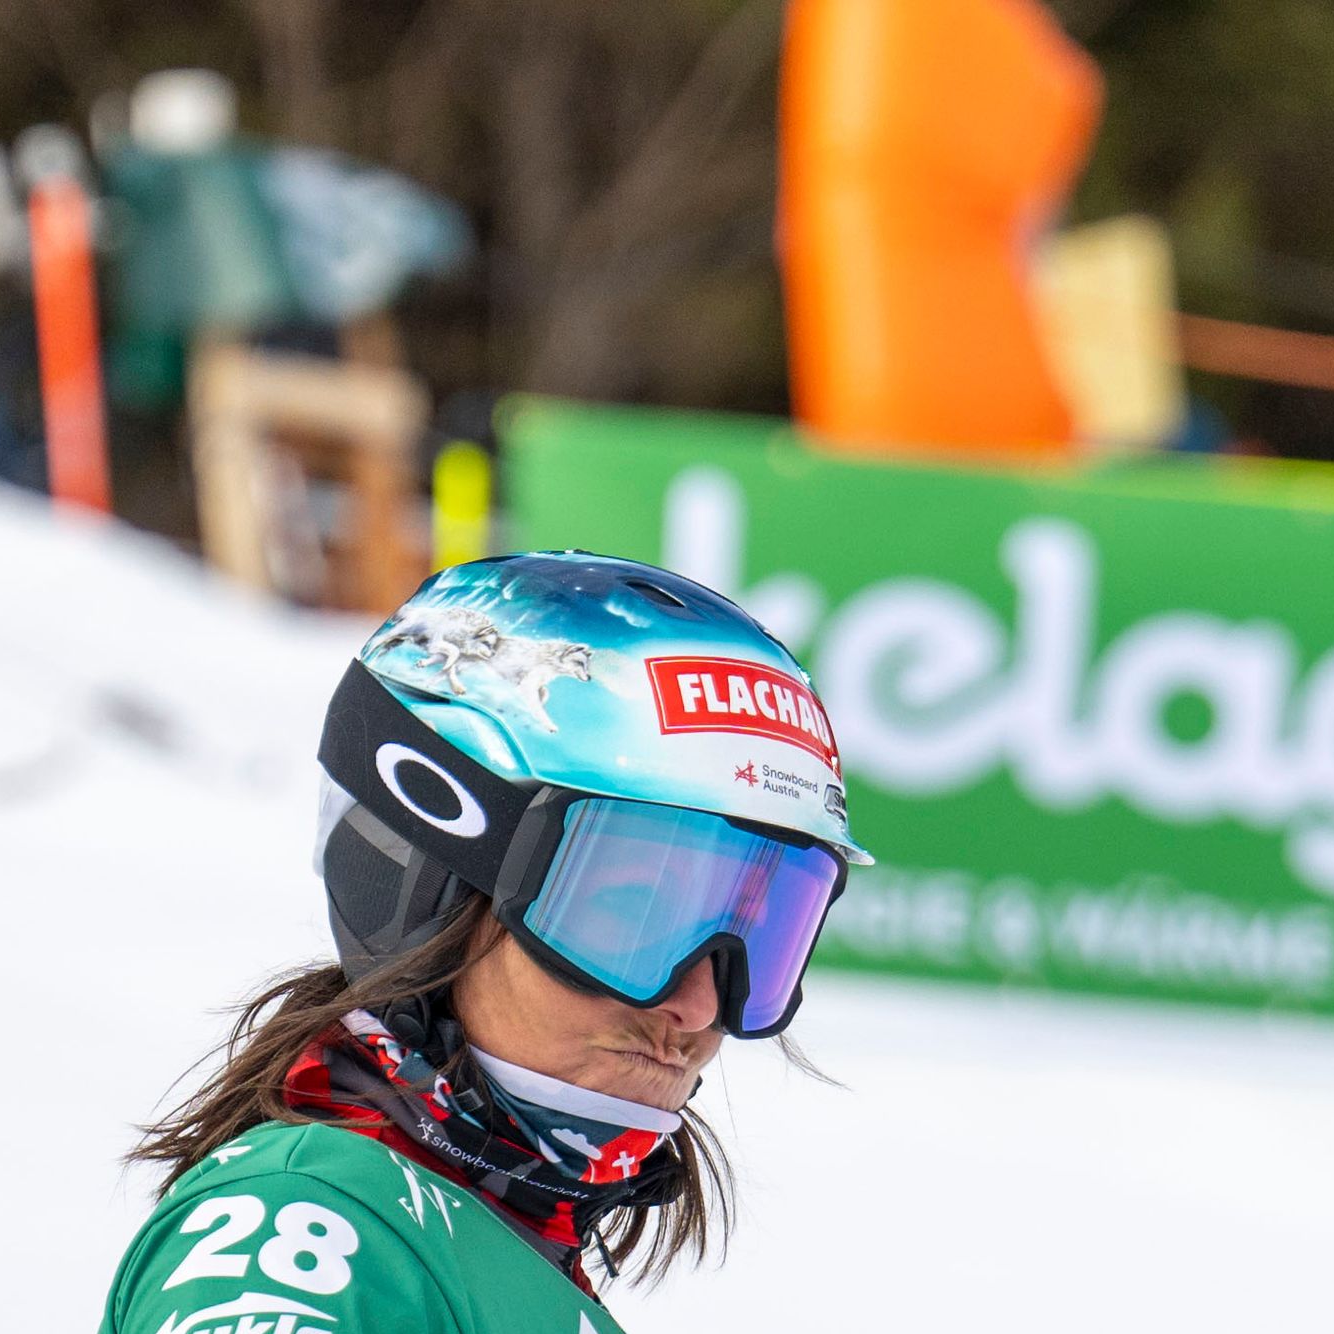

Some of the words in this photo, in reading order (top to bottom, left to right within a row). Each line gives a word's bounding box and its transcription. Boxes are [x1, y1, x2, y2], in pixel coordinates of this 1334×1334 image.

[676, 673, 832, 749] FLACHAU
[762, 764, 818, 793] Snowboard
[763, 779, 800, 799] Austria
[161, 1194, 360, 1295] 28
